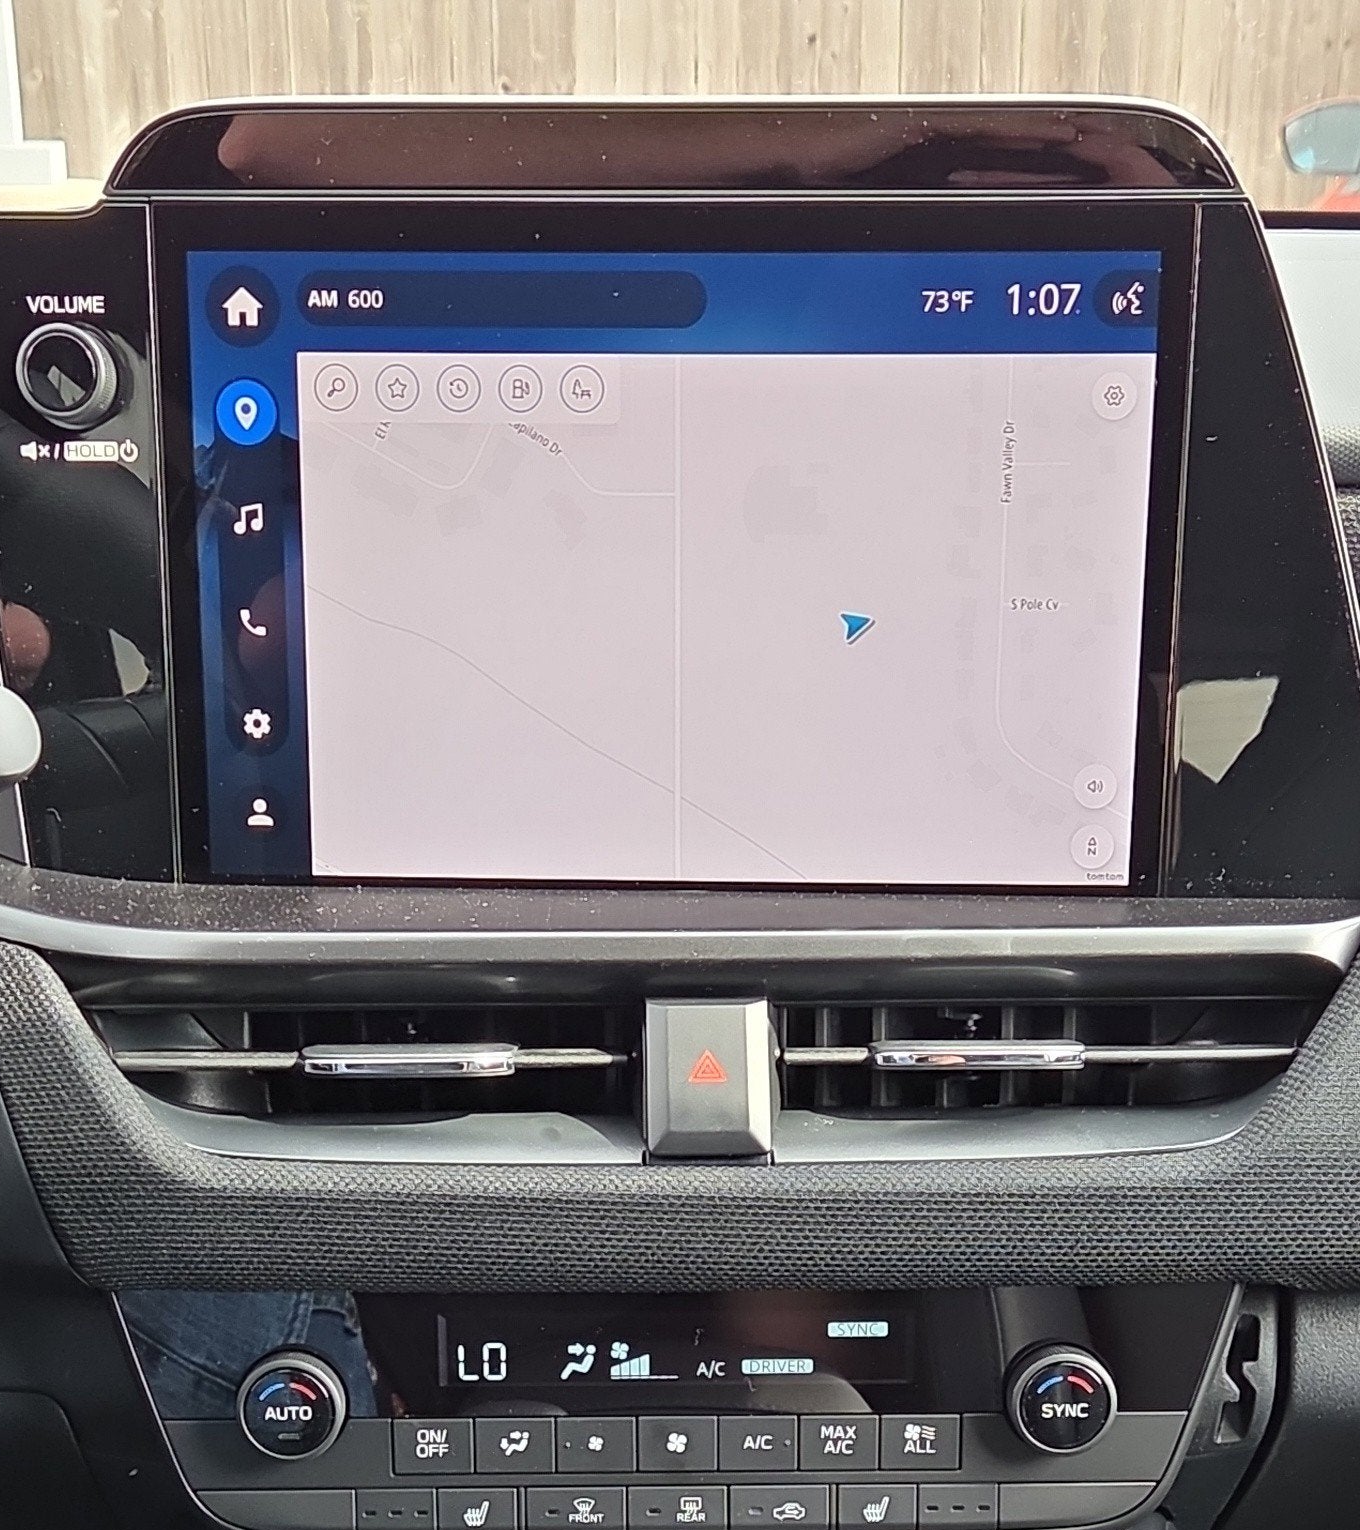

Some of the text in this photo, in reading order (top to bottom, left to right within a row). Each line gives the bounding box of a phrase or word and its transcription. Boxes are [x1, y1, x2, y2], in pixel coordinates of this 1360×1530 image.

[26, 296, 106, 314] VOLUME
[307, 290, 384, 308] AM 600
[921, 290, 974, 312] 73°F
[1006, 283, 1082, 316] 1:07
[67, 444, 116, 458] HOLD
[549, 442, 562, 456] Dr
[1000, 420, 1018, 503] Fawn Valley Dr
[1010, 598, 1059, 610] S Pole Cv
[835, 1322, 879, 1336] SYNC
[458, 1342, 507, 1382] LO
[696, 1360, 727, 1380] A/C
[748, 1360, 807, 1374] DRIVER
[264, 1405, 314, 1422] AUTO
[1041, 1402, 1090, 1419] SYNC
[416, 1428, 448, 1445] ON/
[820, 1425, 857, 1440] MAX
[743, 1434, 774, 1452] A/C
[824, 1440, 855, 1456] A/C
[903, 1440, 937, 1455] ALL
[415, 1444, 450, 1460] OFF
[568, 1512, 605, 1524] FRONT
[676, 1512, 707, 1523] REAR
